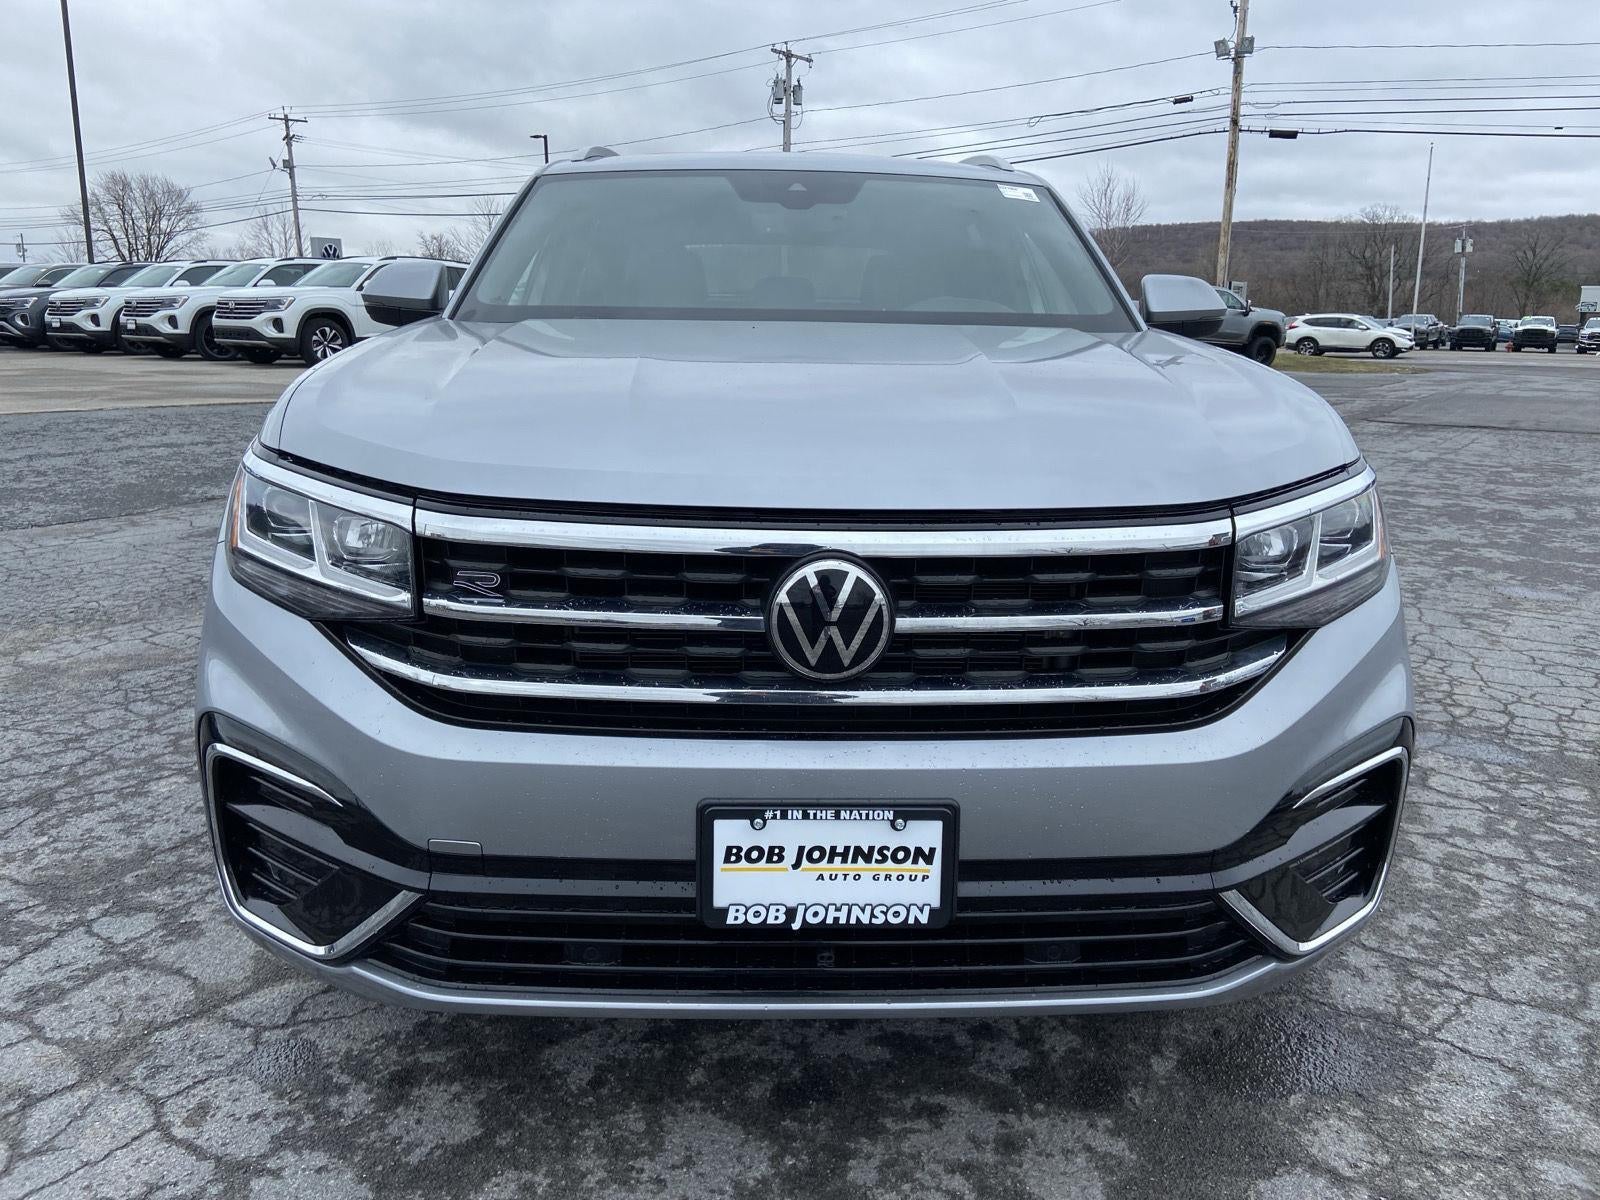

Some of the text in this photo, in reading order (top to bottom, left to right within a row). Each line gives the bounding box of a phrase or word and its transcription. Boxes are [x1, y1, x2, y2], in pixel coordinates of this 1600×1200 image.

[453, 570, 503, 597] R
[764, 810, 894, 820] #1 IN THE NATION
[722, 845, 937, 871] BOB JOHNSON
[816, 873, 930, 883] AUTO GROUP
[725, 904, 930, 930] BOB JOHNSON
